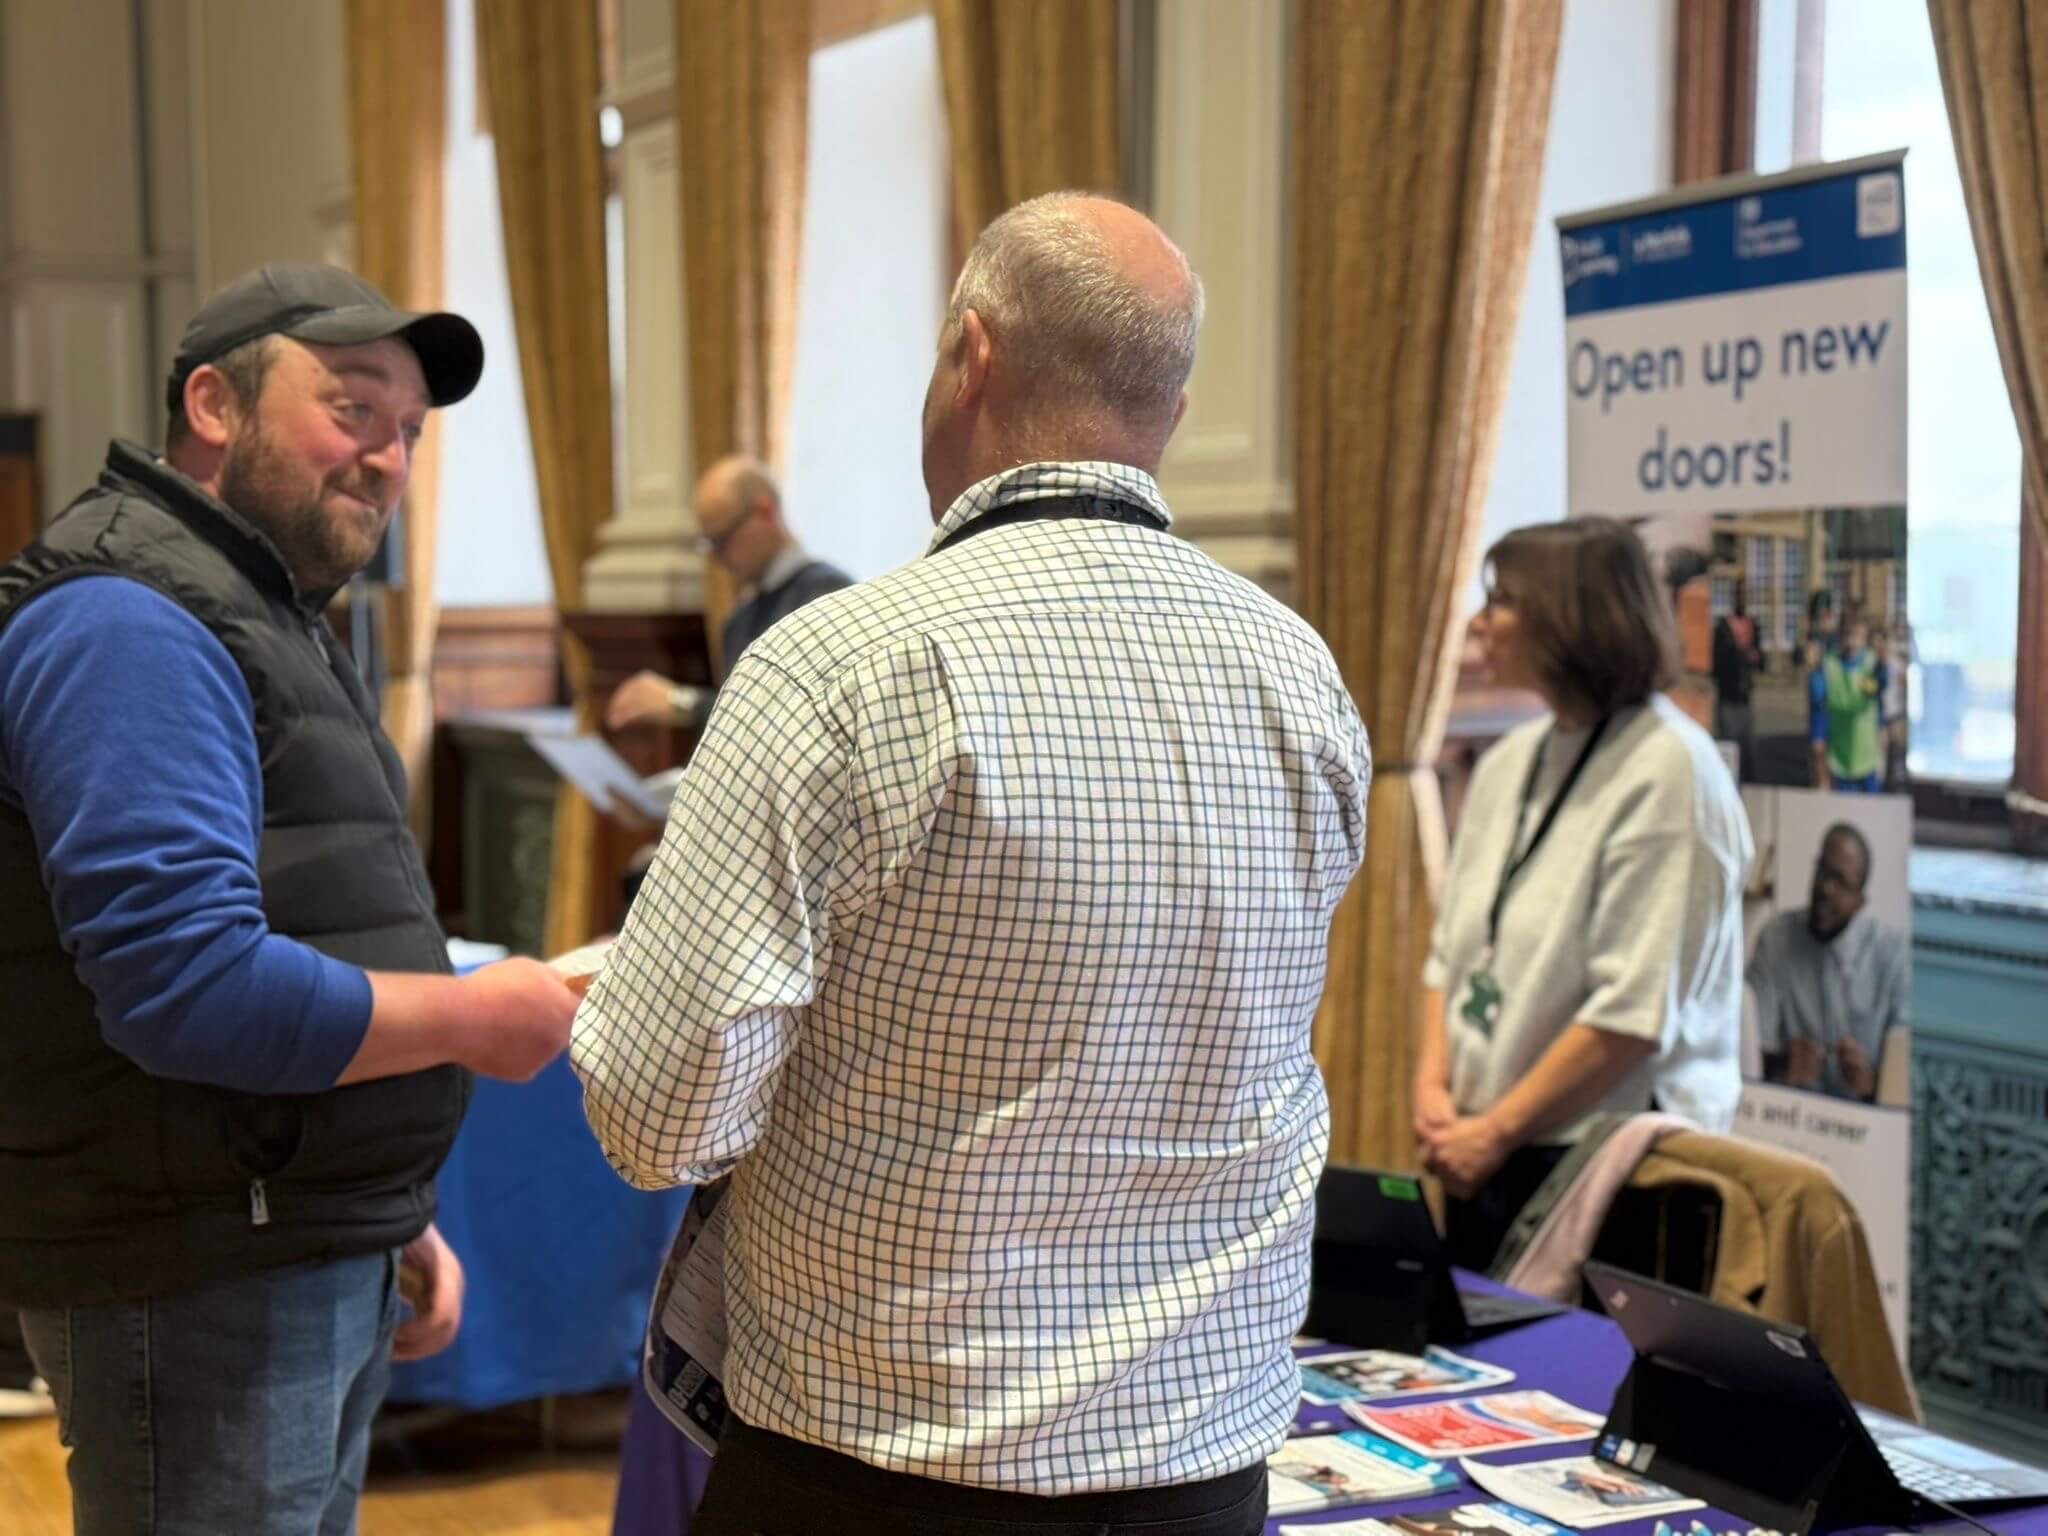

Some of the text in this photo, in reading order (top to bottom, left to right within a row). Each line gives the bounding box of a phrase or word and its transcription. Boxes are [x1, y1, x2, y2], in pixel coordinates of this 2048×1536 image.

[1568, 319, 1891, 414] Open up new
[1637, 418, 1792, 491] doors!
[1763, 1103, 1799, 1129] and
